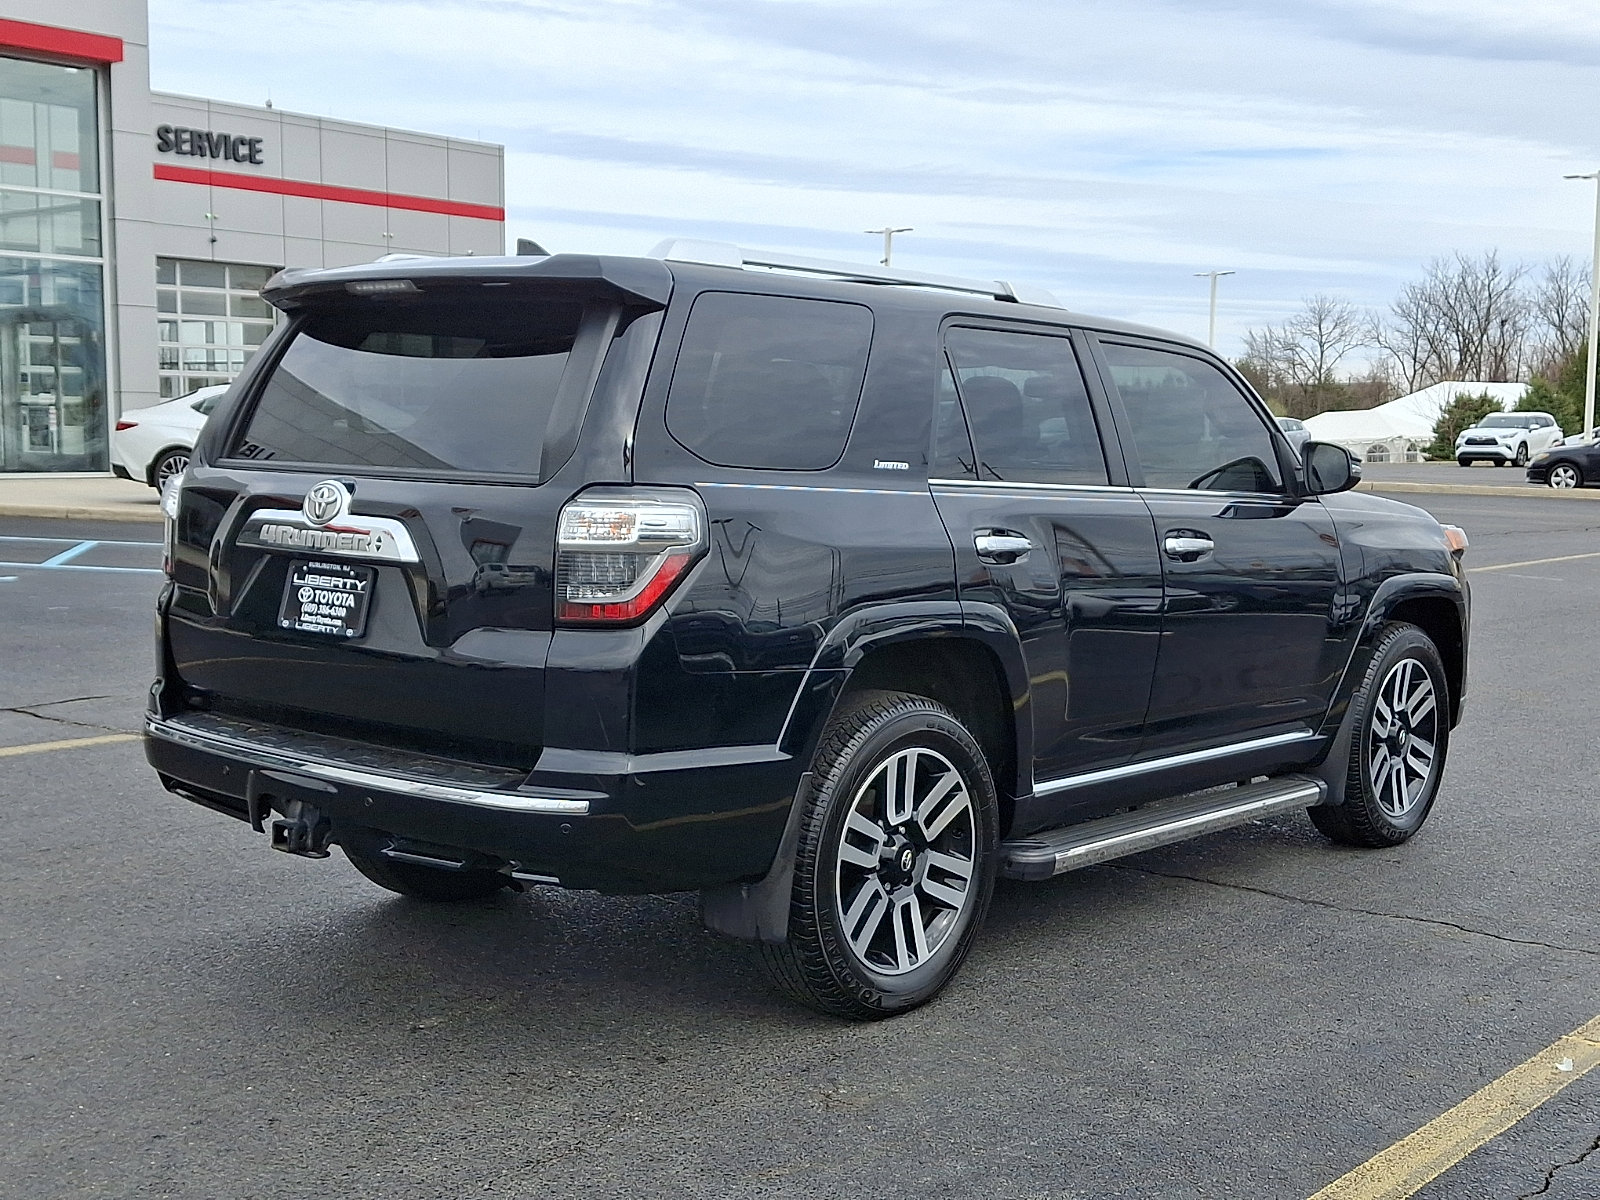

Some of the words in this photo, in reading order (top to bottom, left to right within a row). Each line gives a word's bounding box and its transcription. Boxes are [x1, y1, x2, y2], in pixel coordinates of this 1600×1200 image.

[157, 124, 264, 165] SERVICE
[293, 572, 367, 591] LIBERTY
[314, 589, 355, 609] TOYOTA
[295, 621, 339, 634] LIBERTY
